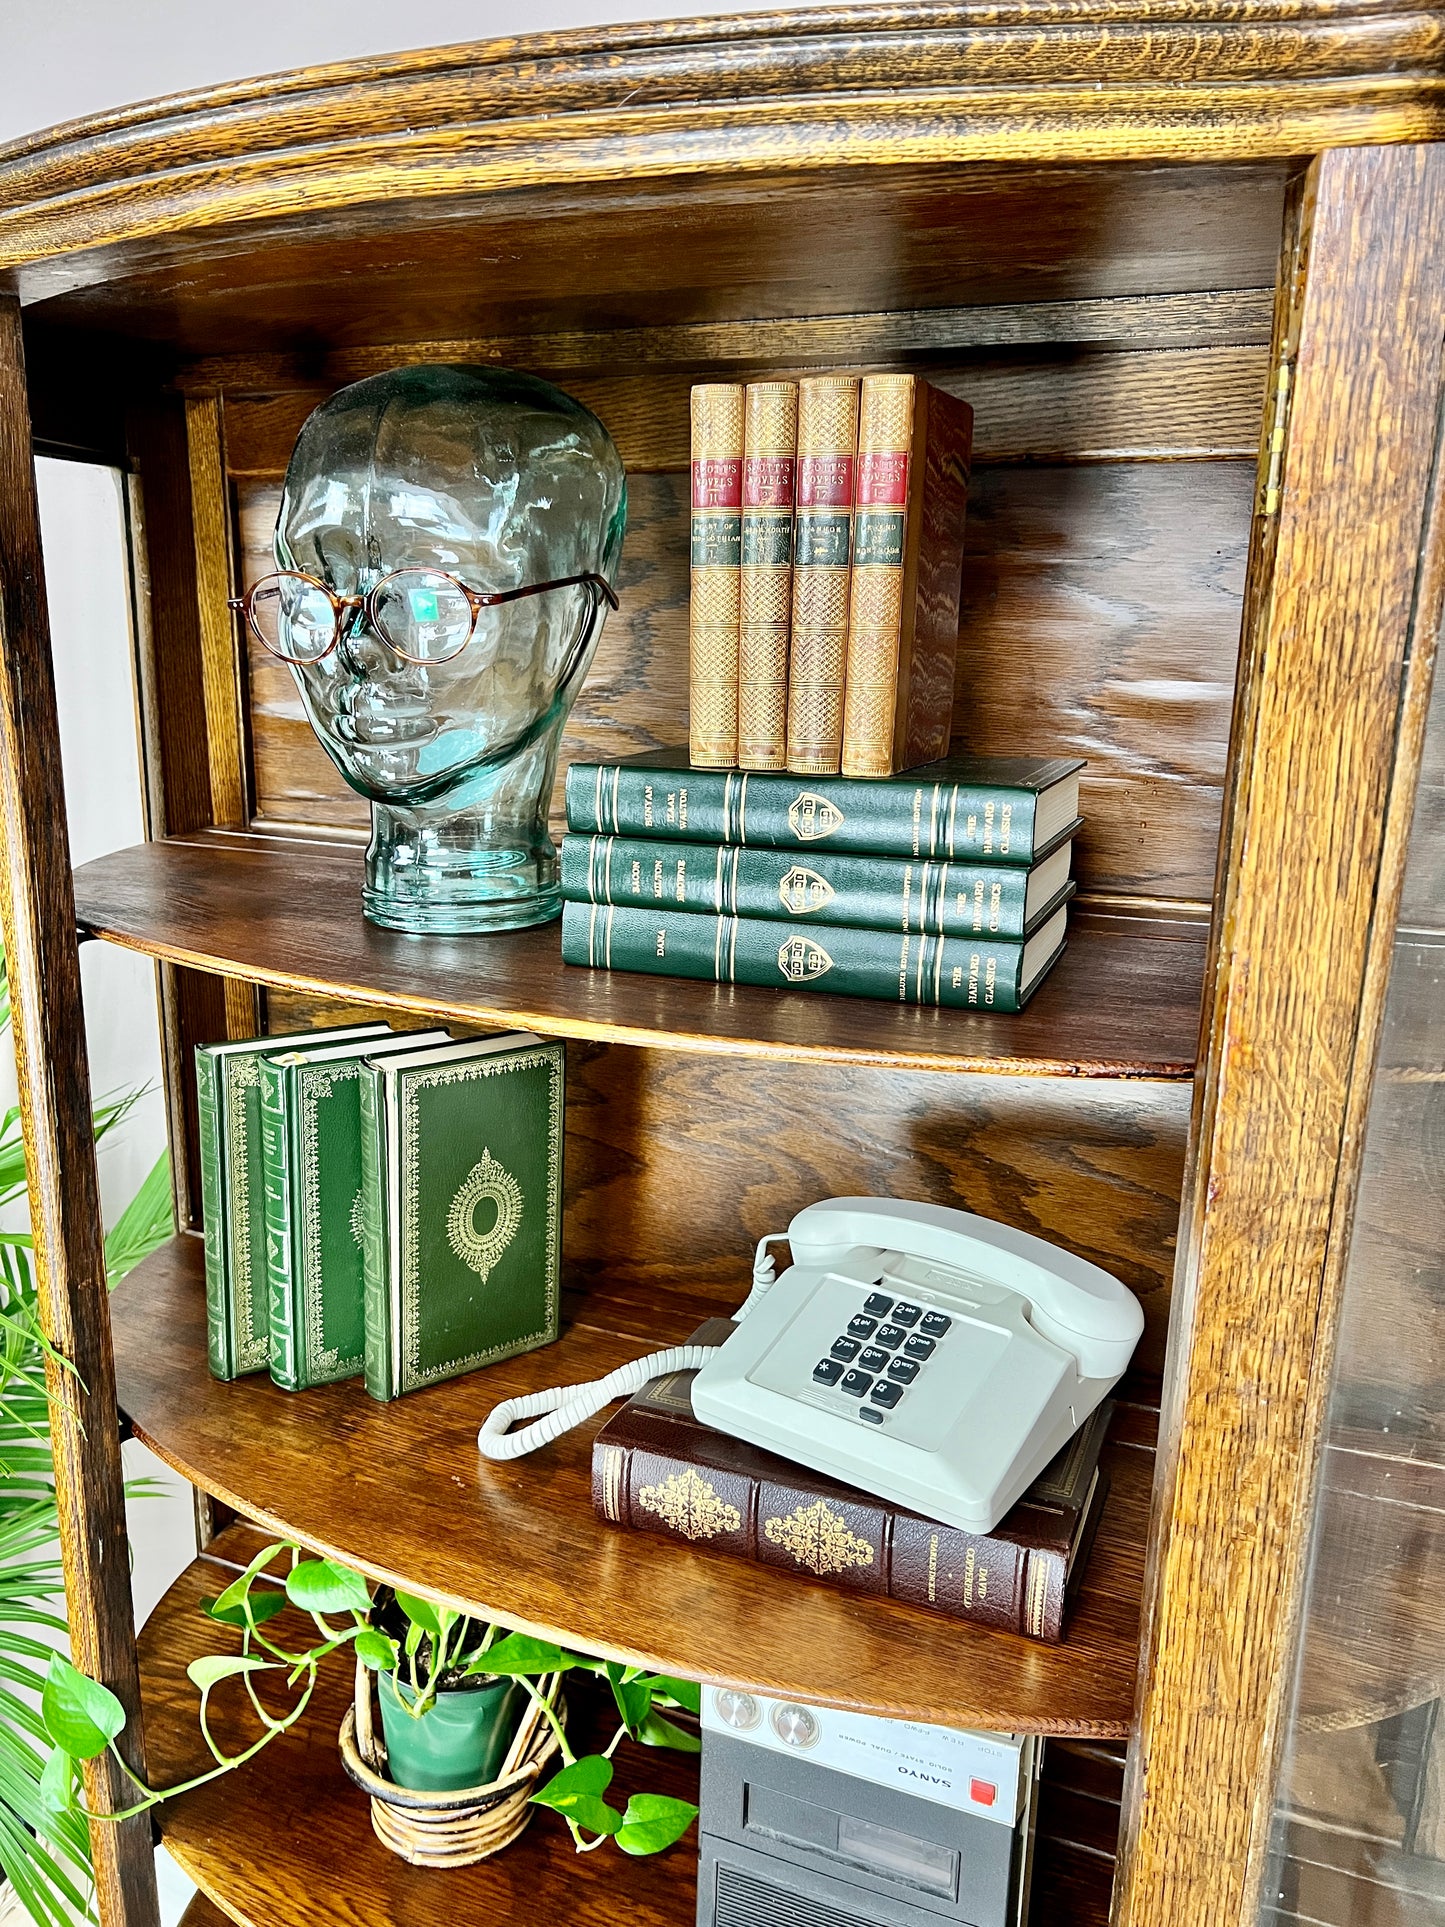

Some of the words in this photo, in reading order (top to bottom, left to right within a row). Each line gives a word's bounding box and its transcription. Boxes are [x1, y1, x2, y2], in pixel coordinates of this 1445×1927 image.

[694, 464, 737, 474] SCOTT'S
[747, 463, 790, 473] SCOTT'S
[802, 462, 847, 474] SCOTT'S
[860, 460, 904, 470] SCOTT'S
[695, 477, 733, 487] NOVELS
[748, 475, 788, 485] NOVELS
[803, 475, 844, 485] NOVELS
[861, 472, 900, 482] NOVELS
[644, 785, 653, 827] BUNYAN
[667, 792, 675, 823] IZAAK
[679, 788, 688, 830] WALTON
[913, 788, 923, 823] EDITION
[967, 814, 977, 838] THE
[983, 801, 995, 855] HARVARD
[1000, 803, 1012, 855] CLASSICS
[632, 860, 640, 894] BACON
[654, 859, 663, 898] MILTON
[676, 859, 686, 903] BROWNE
[903, 865, 913, 899] EDITION
[956, 892, 967, 915] THE
[972, 880, 984, 932] HARVARD
[990, 882, 1001, 932] CLASSICS
[656, 929, 666, 957] DANA
[900, 935, 910, 970] EDITION
[952, 966, 962, 989] THE
[968, 953, 980, 1004] HARVARD
[985, 957, 997, 1005] CLASSICS
[868, 1295, 875, 1303] 1
[895, 1304, 905, 1313] 2
[852, 1318, 861, 1326] 4
[924, 1314, 934, 1323] 3
[836, 1339, 844, 1347] 7
[908, 1336, 918, 1345] 6
[863, 1348, 873, 1357] 8
[891, 1359, 901, 1368] 9
[929, 1534, 939, 1570] CHARLES
[928, 1570, 937, 1602] DICKENS
[963, 1547, 976, 1608] COPPERFIELD
[977, 1567, 988, 1599] DAVID
[838, 1734, 866, 1746] POWER
[898, 1766, 952, 1788] SANYO
[929, 1762, 953, 1773] SOLID
